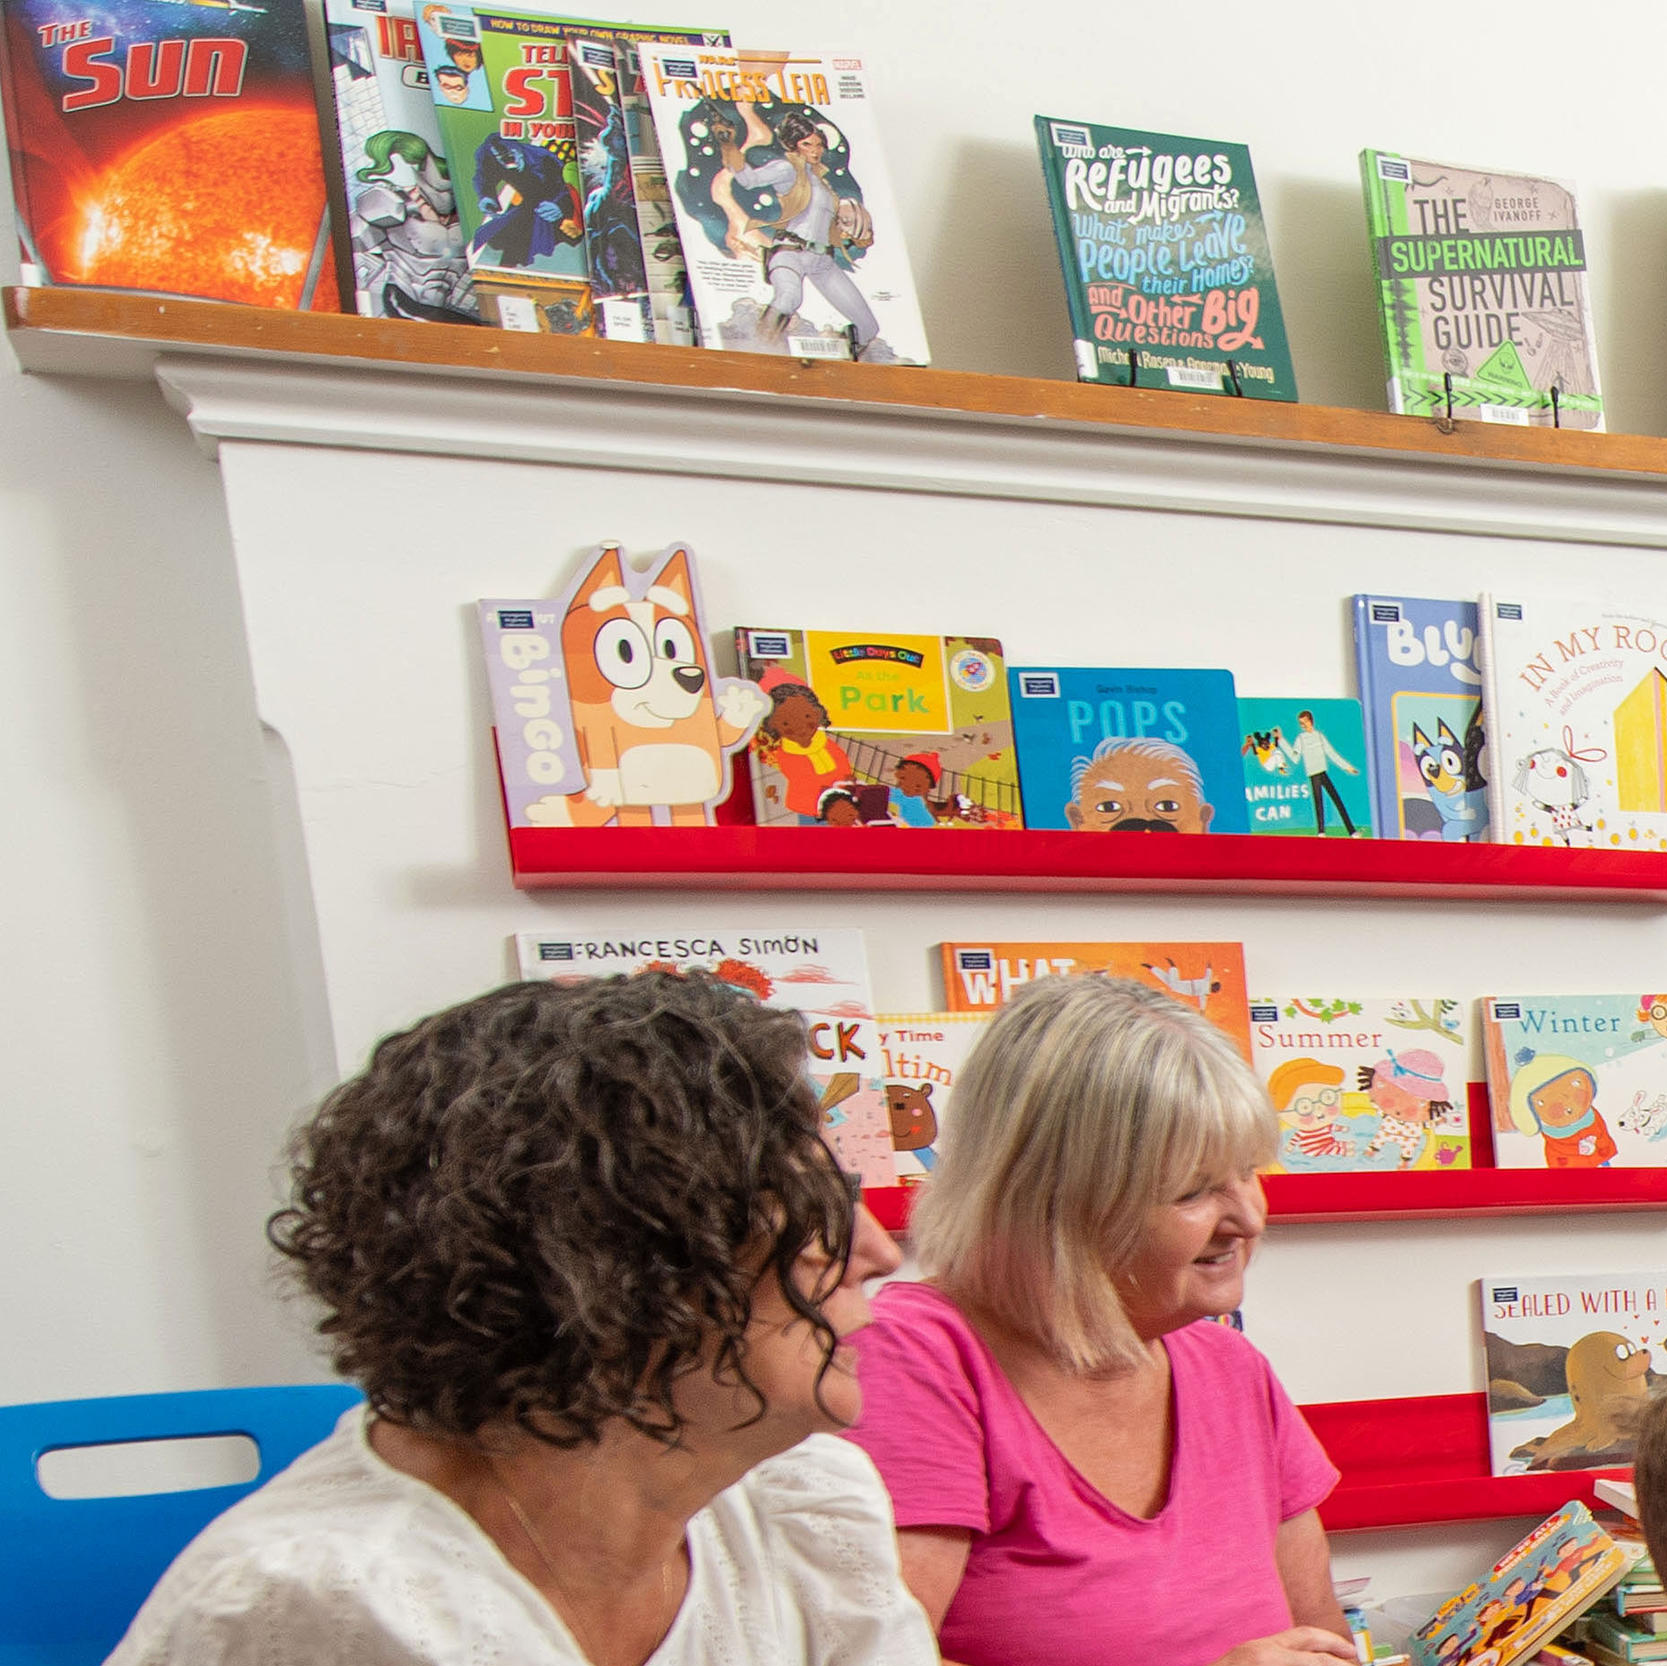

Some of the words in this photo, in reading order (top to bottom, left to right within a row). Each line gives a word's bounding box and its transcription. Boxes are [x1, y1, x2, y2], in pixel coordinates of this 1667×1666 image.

[775, 69, 831, 105] LEIA
[1413, 199, 1470, 234] THE
[1494, 198, 1539, 210] GEORGE
[1494, 210, 1542, 222] IVANOFF
[1072, 212, 1129, 245] What
[1136, 219, 1196, 245] makes
[1077, 238, 1174, 285] People
[1391, 236, 1584, 273] SUPERNATURAL
[1428, 271, 1574, 313] SURVIVAL
[1094, 313, 1214, 350] Questions
[1434, 312, 1523, 351] GUIDE
[833, 647, 866, 660] Little
[866, 647, 896, 660] Days
[898, 651, 920, 663] Out
[1519, 653, 1555, 691] IN
[1553, 626, 1601, 663] MY
[840, 686, 929, 714] Park
[1068, 700, 1188, 745] POPS
[1255, 806, 1291, 821] CAN
[896, 1030, 944, 1042] Time
[1257, 1025, 1383, 1049] Summer
[1519, 1009, 1621, 1035] Winter
[1580, 1288, 1637, 1314] WITH
[1646, 1288, 1657, 1311] A
